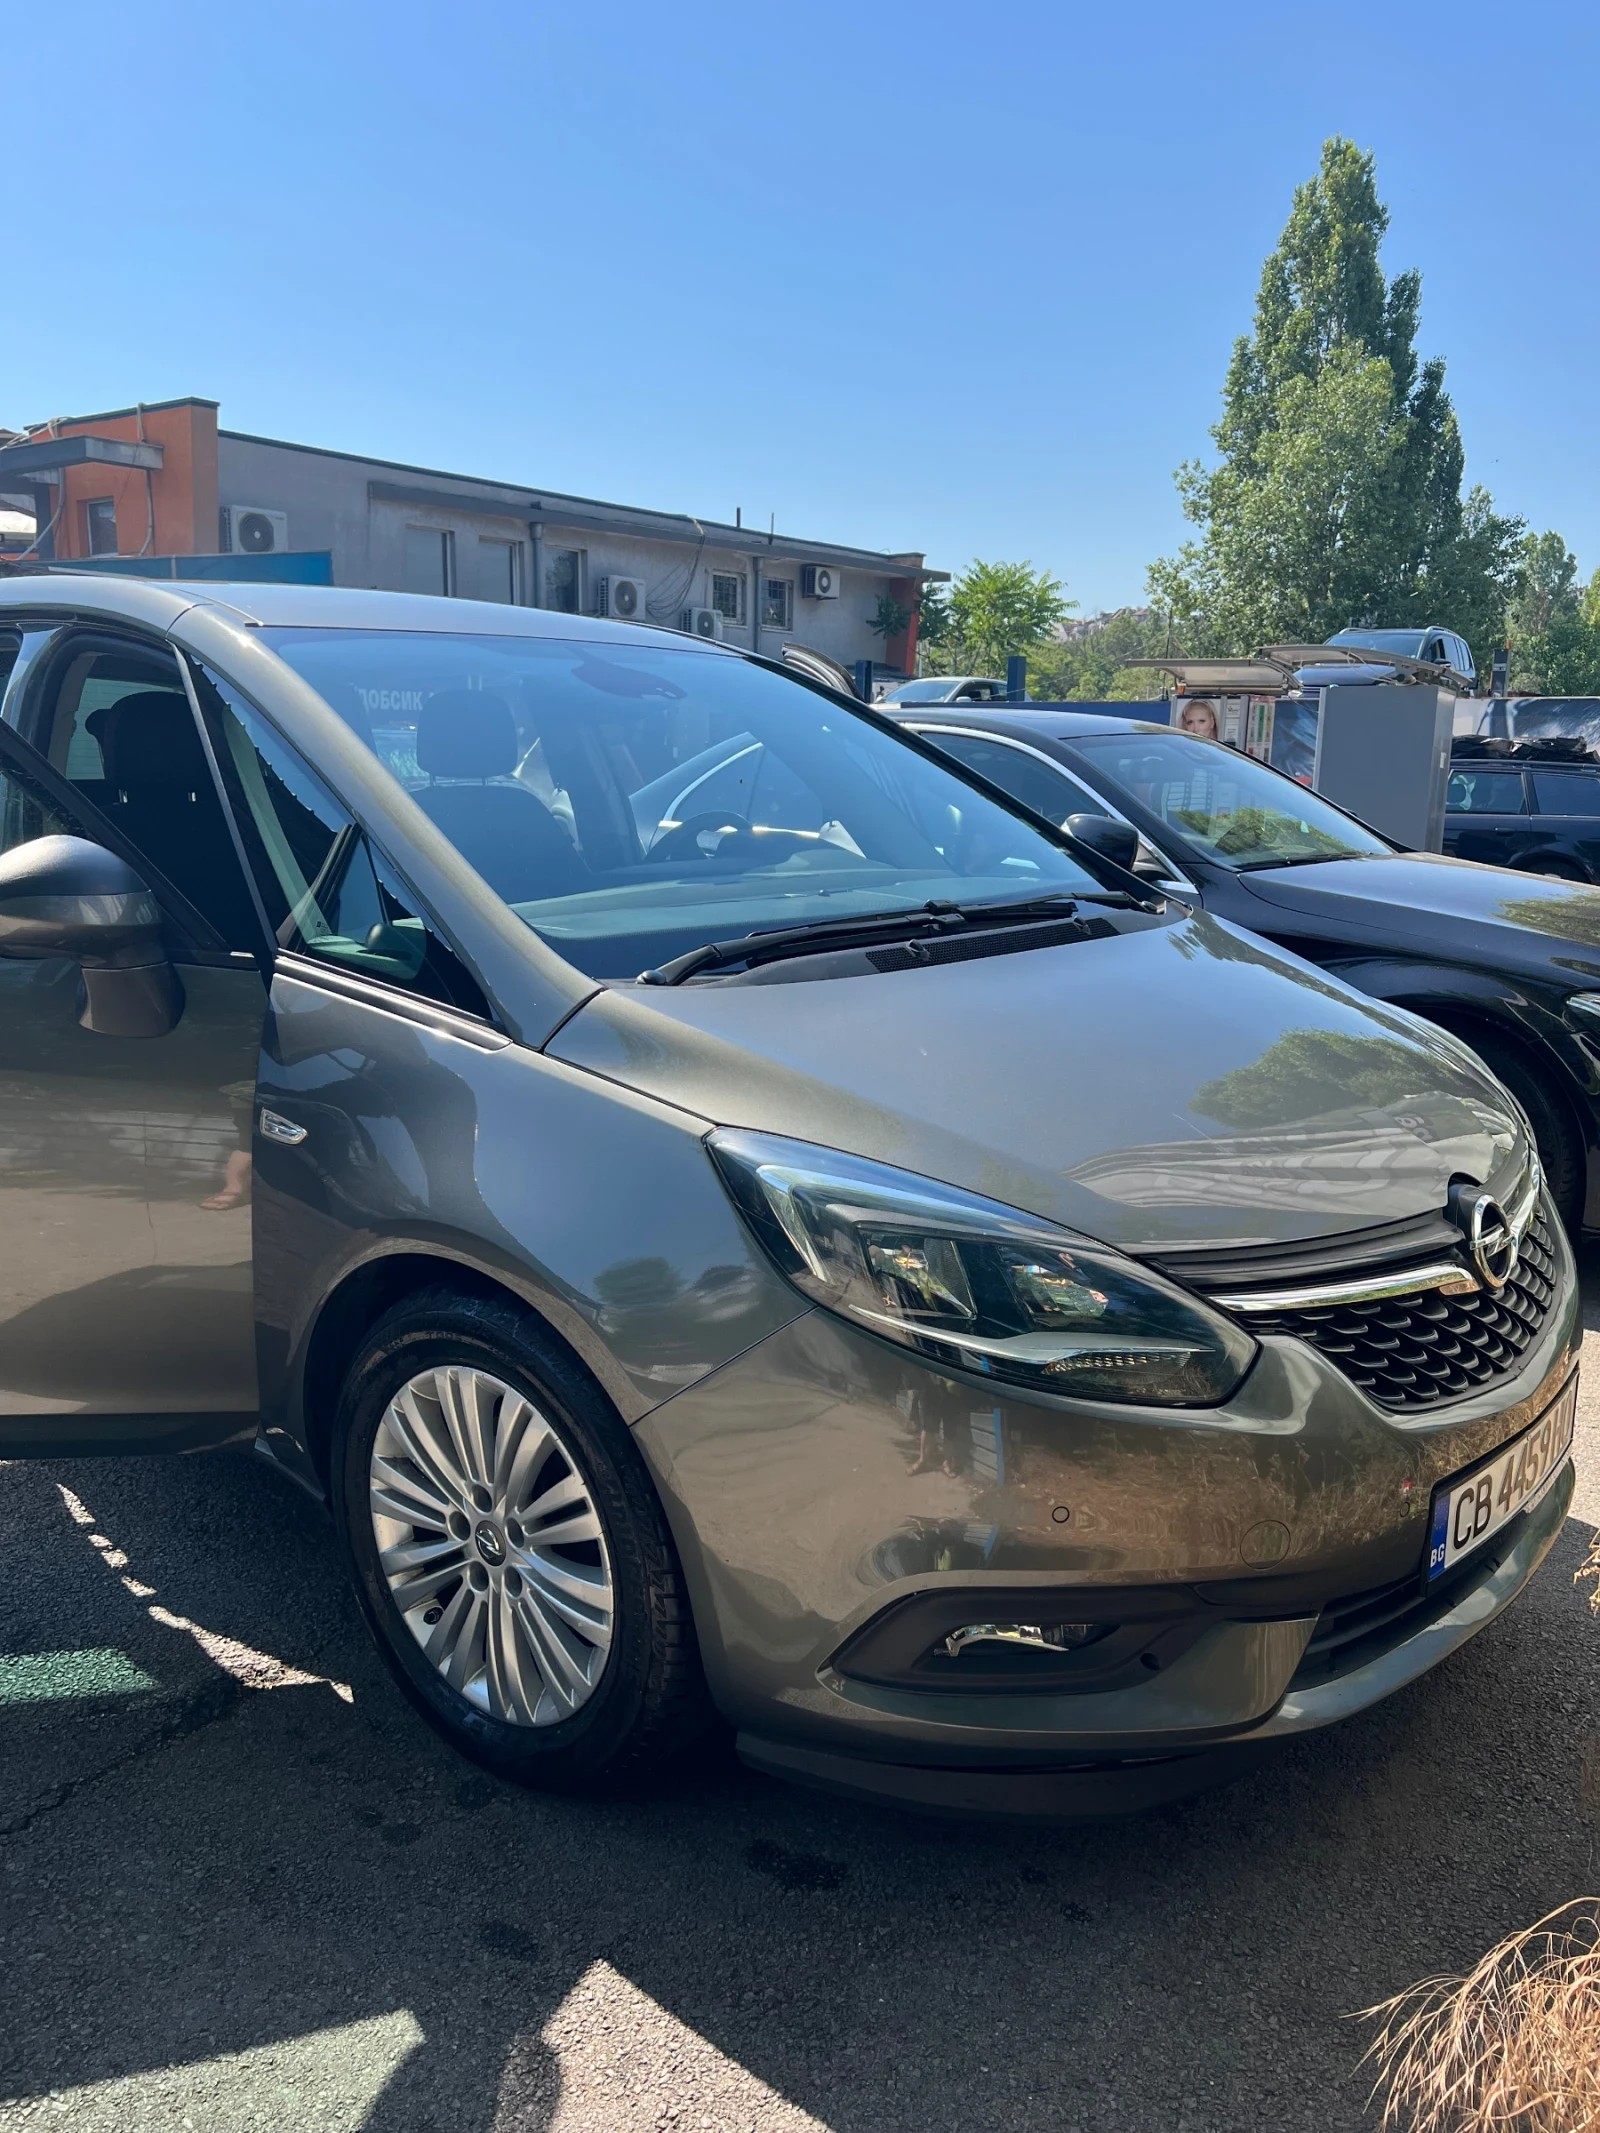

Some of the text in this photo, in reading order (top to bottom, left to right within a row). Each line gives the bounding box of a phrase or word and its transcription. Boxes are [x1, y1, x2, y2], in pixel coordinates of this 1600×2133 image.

[1453, 1474, 1493, 1550] CB
[1496, 1419, 1552, 1514] 4459
[1430, 1543, 1445, 1568] BG
